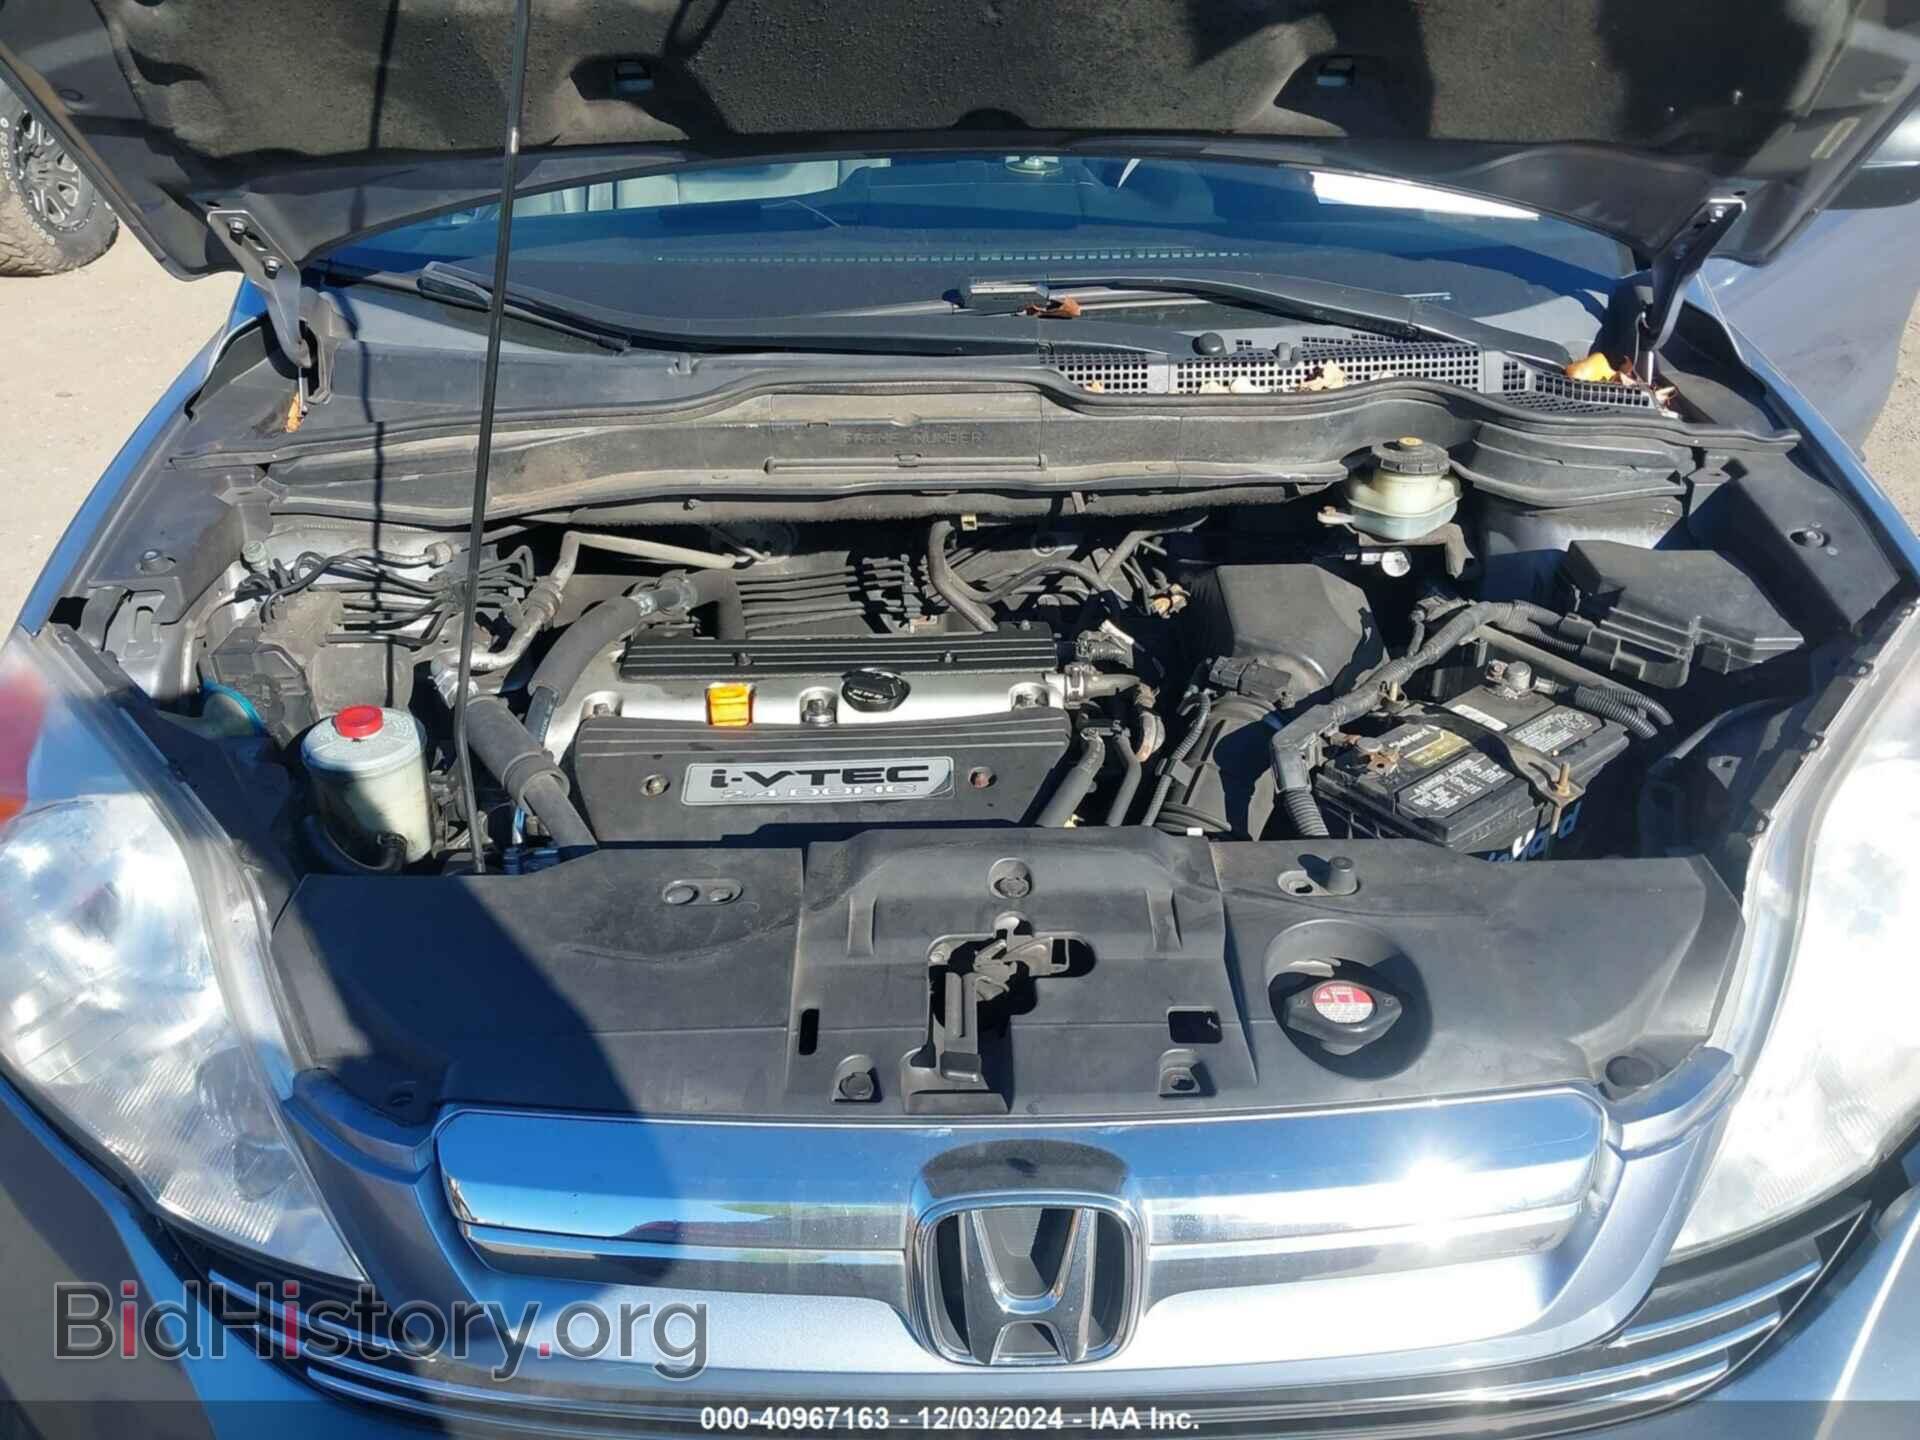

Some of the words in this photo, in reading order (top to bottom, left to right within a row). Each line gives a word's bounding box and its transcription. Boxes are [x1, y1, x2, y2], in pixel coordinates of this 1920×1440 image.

[912, 432, 984, 445] NUMBER
[710, 765, 930, 789] i-VTEC
[789, 784, 919, 798] DOHC
